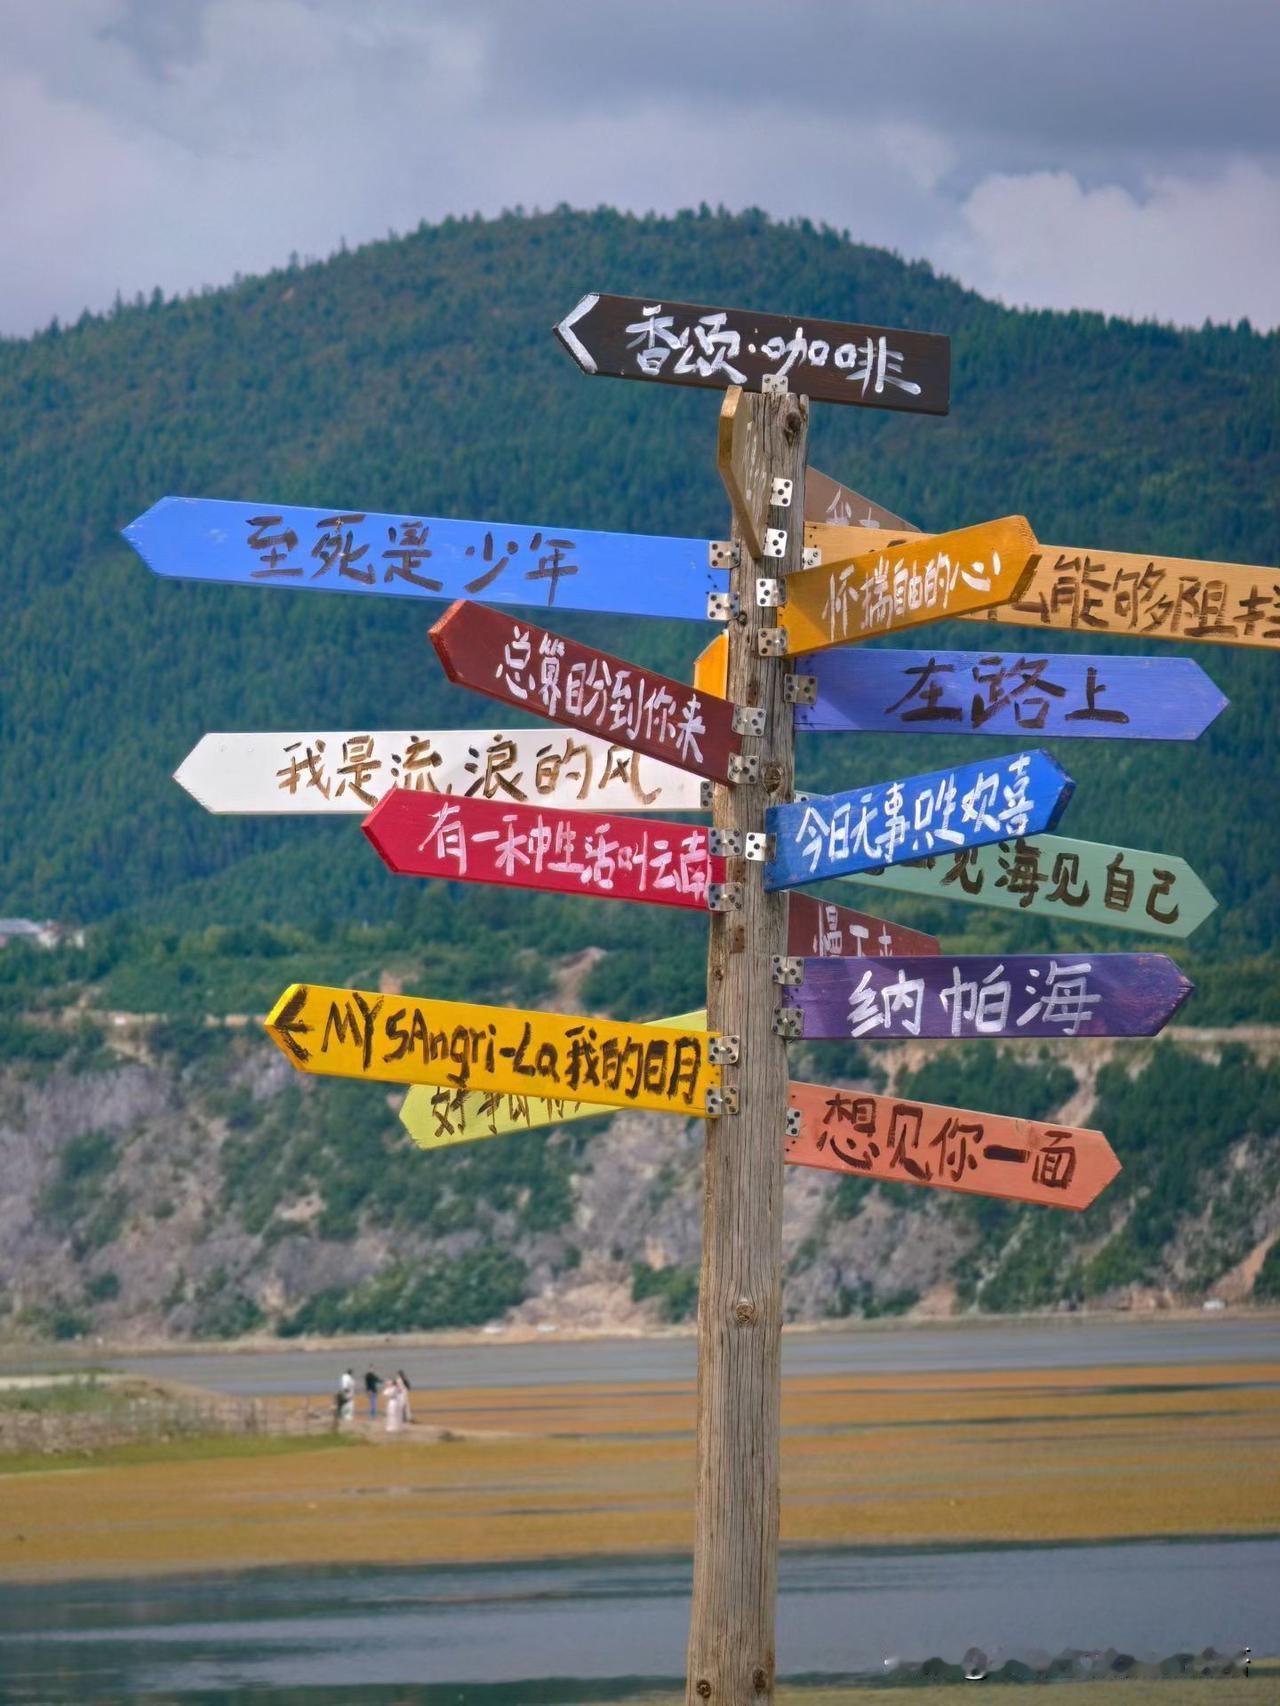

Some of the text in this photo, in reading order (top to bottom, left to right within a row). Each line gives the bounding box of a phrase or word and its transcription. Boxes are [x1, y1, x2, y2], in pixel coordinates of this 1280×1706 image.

[246, 513, 580, 607] 至死是少年
[821, 550, 1002, 642] 怀揣自由的心
[495, 625, 706, 764] 总算盼到你来
[276, 733, 662, 807] 我是流浪的风
[795, 753, 1035, 874] 今日无事只生欢喜
[418, 802, 712, 902] 有一种生活叫云南
[321, 992, 385, 1072] MY
[847, 960, 1102, 1038] 纳帕海
[815, 1093, 1077, 1190] 想见你一面
